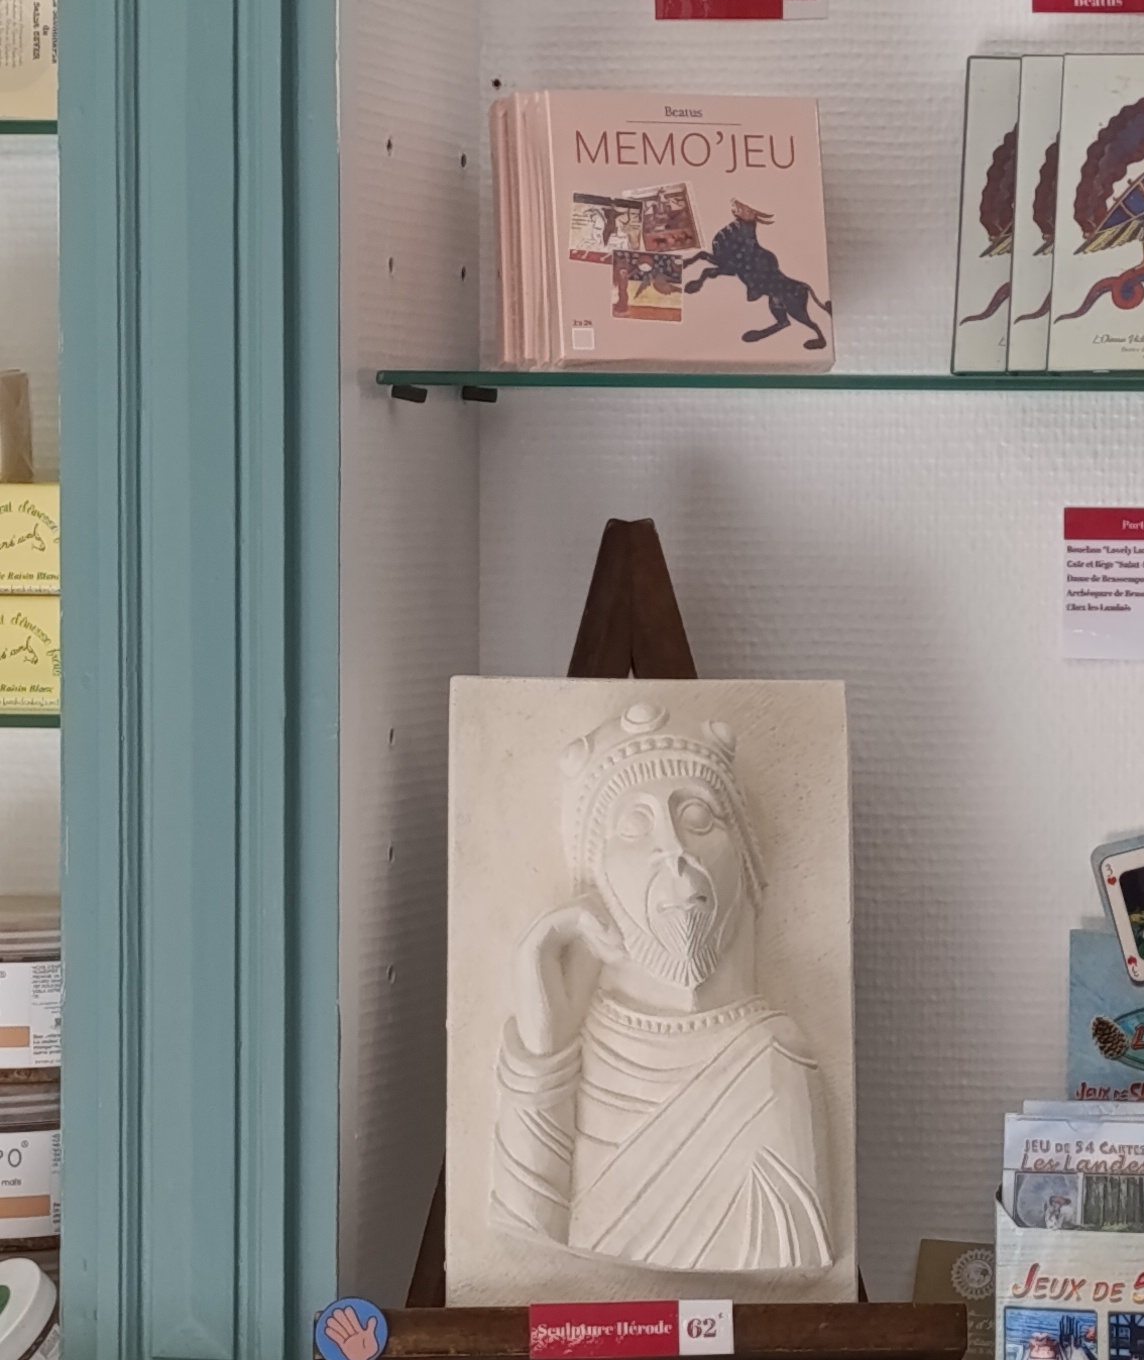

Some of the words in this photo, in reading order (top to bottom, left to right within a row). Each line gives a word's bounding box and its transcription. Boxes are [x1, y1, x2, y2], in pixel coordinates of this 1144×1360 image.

[664, 106, 703, 118] Beatus
[575, 130, 795, 173] MEMO'JEU
[1024, 1139, 1050, 1153] JEU
[1075, 1141, 1095, 1154] 54
[1021, 1153, 1060, 1172] Les
[1012, 1263, 1086, 1302] JEUX
[537, 1322, 614, 1342] Sculpture
[616, 1321, 673, 1337] Hérode
